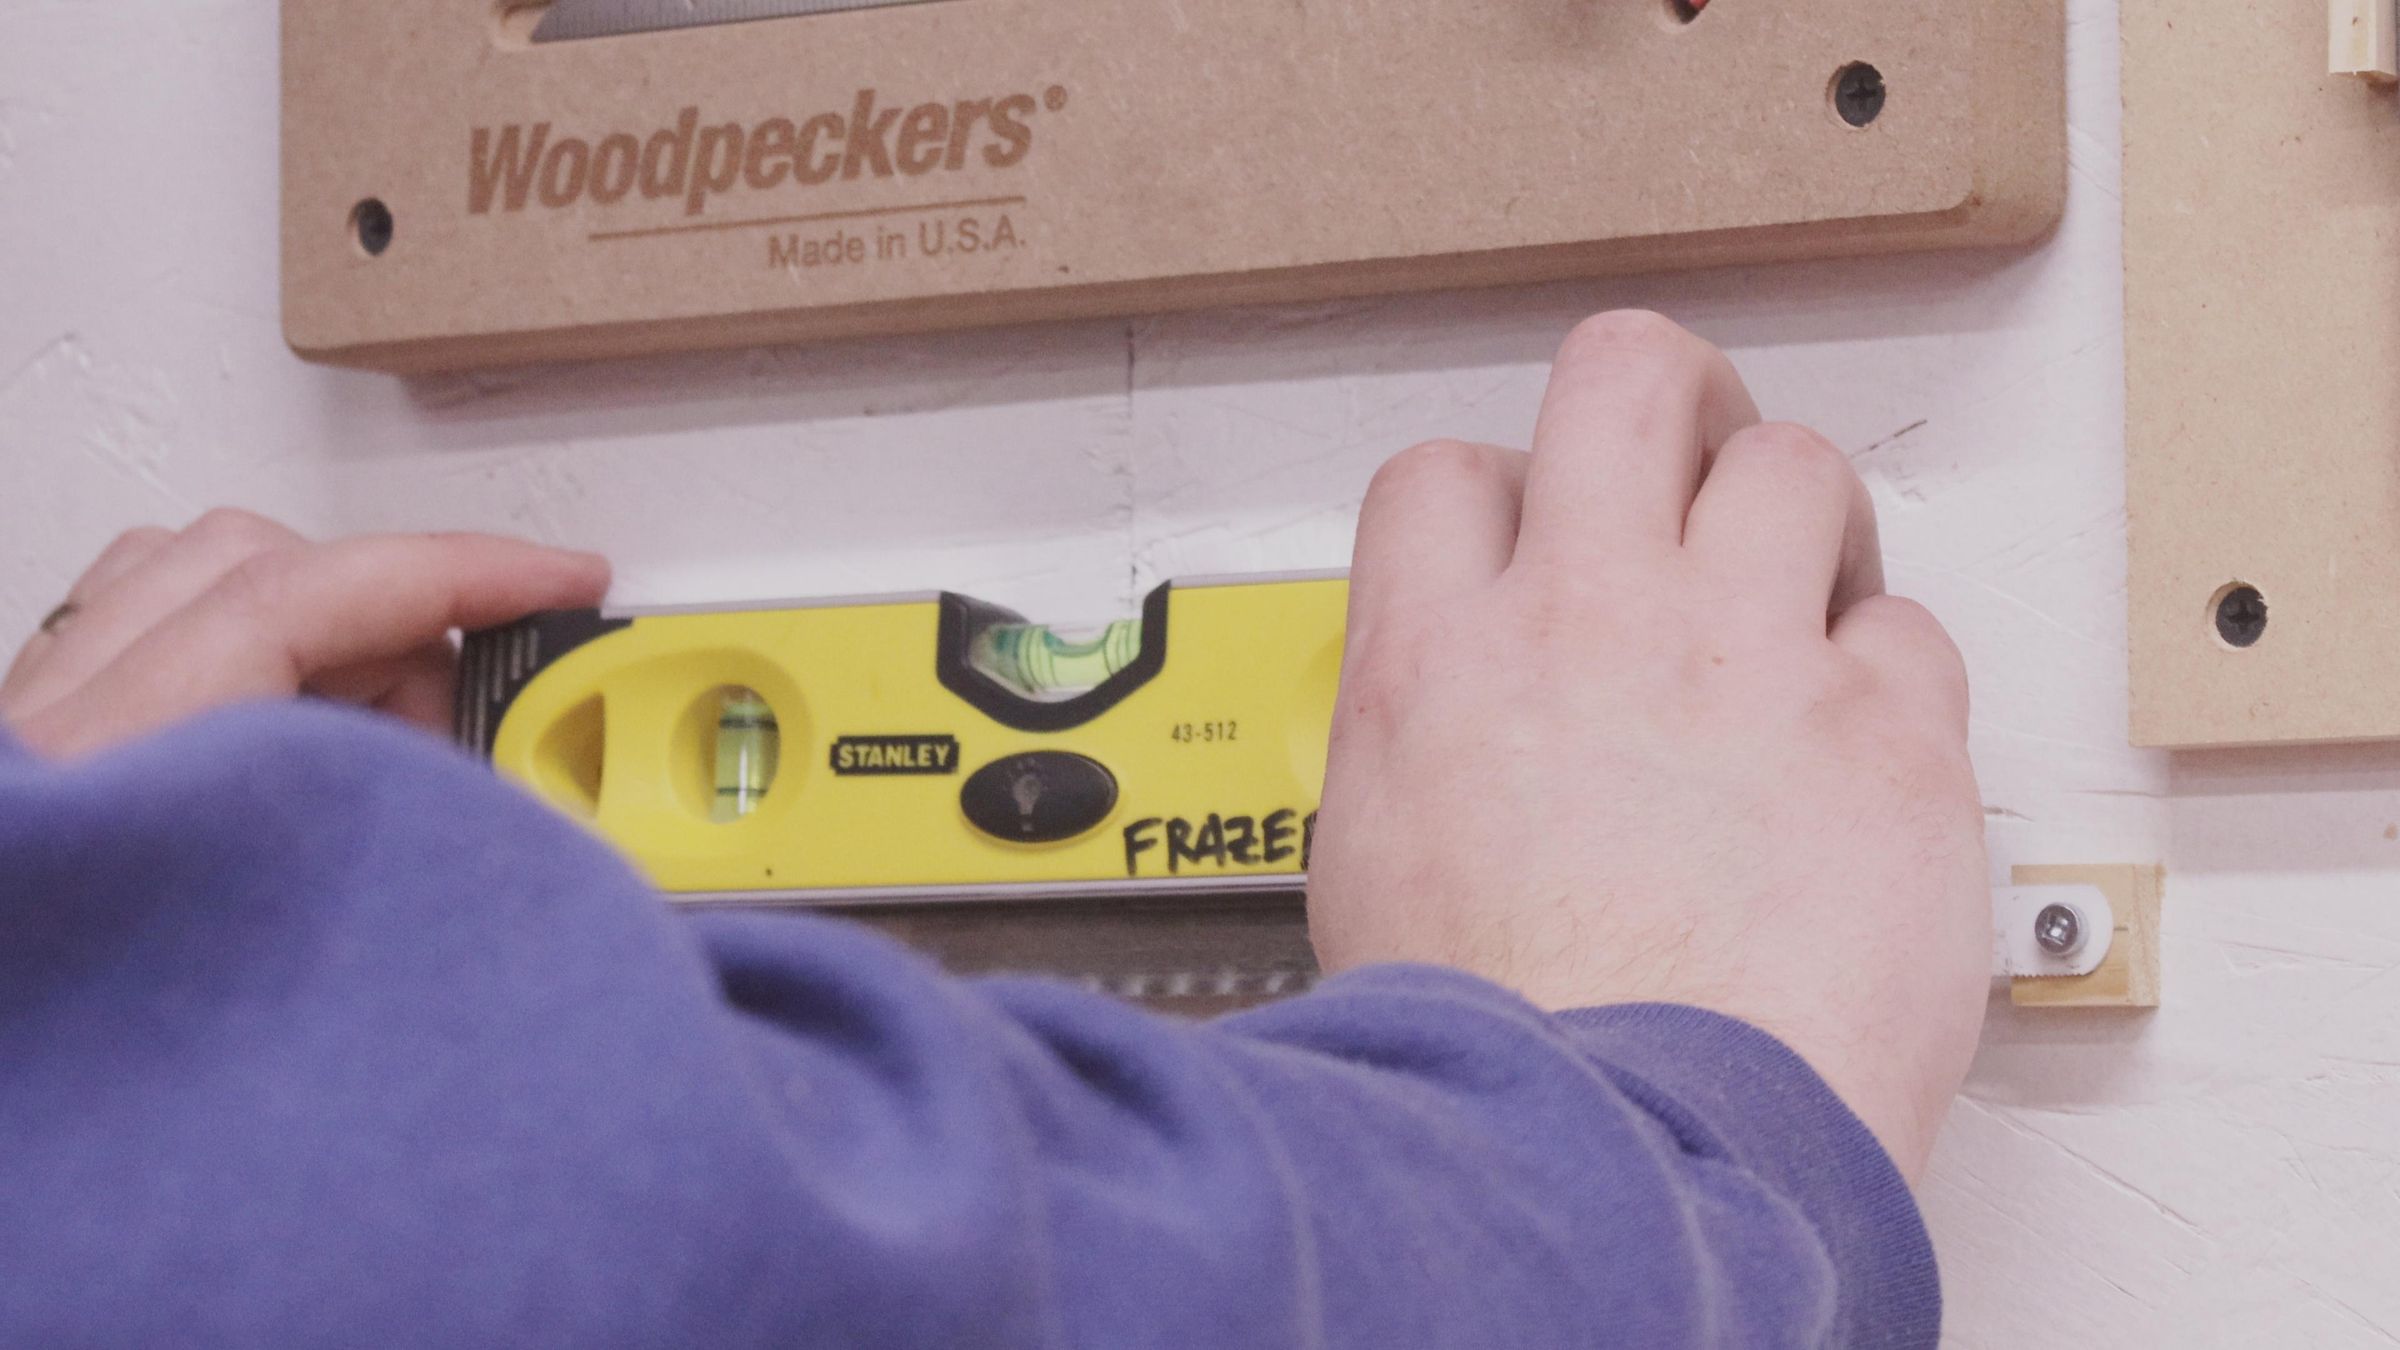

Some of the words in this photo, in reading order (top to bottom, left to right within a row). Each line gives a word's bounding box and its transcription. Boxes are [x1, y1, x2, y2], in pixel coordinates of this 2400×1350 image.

[768, 229, 866, 269] Made
[876, 225, 907, 261] in
[919, 214, 1027, 256] U.S.A.
[1171, 721, 1238, 743] 43-512
[837, 742, 952, 768] STANLEY
